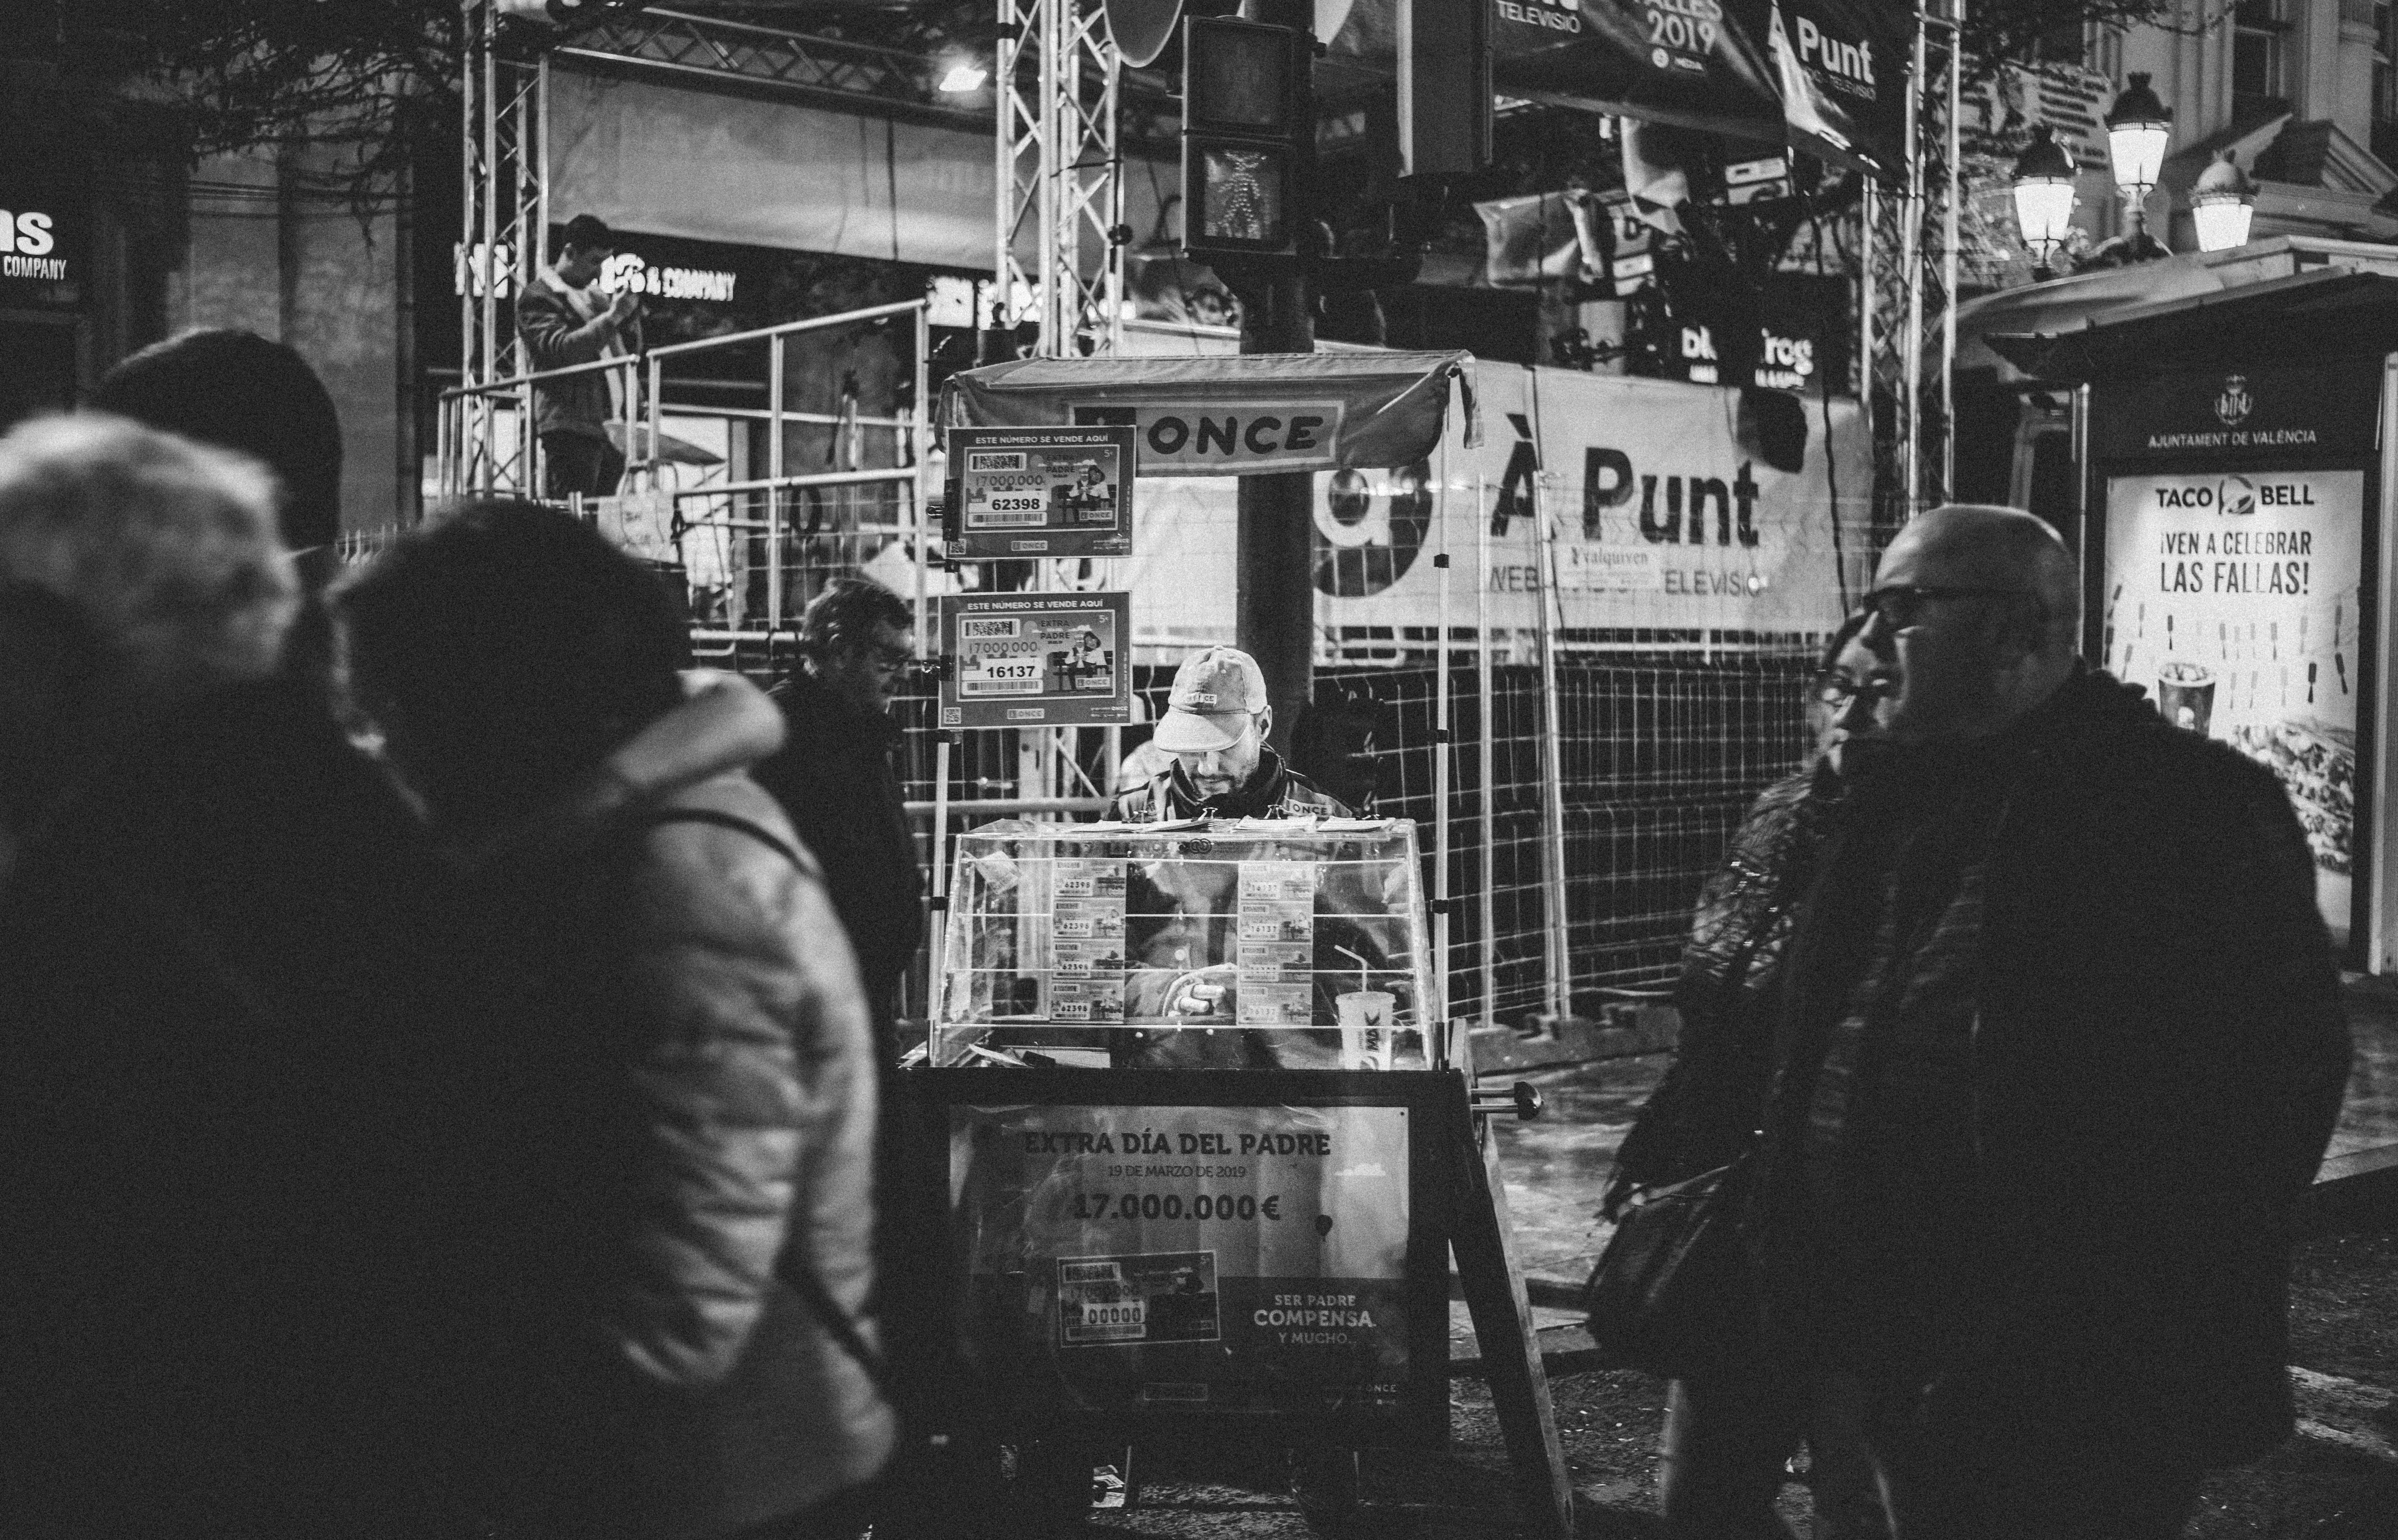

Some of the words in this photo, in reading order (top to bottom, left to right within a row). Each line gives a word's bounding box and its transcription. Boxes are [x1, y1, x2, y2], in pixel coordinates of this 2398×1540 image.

[1648, 9, 1716, 56] 2019
[1796, 16, 1875, 84] Punt
[3, 256, 66, 280] COMPANY
[1086, 434, 1108, 442] AQUÍ
[1148, 416, 1324, 456] ONCE
[2148, 433, 2227, 448] AJUNTAMENT
[2232, 432, 2248, 445] DE
[992, 499, 1040, 510] 62398
[1584, 446, 1759, 546] Punt
[2156, 487, 2213, 507] TACO
[2261, 484, 2314, 505] BELL
[2207, 532, 2216, 555] A
[2223, 531, 2312, 555] CELEBRAR
[2161, 562, 2203, 593] LAS
[2214, 561, 2309, 594] FALLAS!
[992, 601, 1031, 609] NÚMERO
[1080, 599, 1104, 607] AQUÍ
[987, 666, 1035, 678] 16137
[1293, 804, 1327, 816] ONCE
[1024, 1132, 1115, 1154] EXTRA
[1121, 1128, 1172, 1154] DÍA
[1179, 1133, 1232, 1155] DEL
[1240, 1134, 1331, 1156] PADRE
[1108, 1166, 1123, 1177] 19
[1126, 1166, 1144, 1177] DE
[1145, 1166, 1193, 1177] MARZO
[1196, 1166, 1214, 1177] DE
[1216, 1166, 1245, 1177] 2019
[1074, 1194, 1280, 1221] 17.000.000€
[1275, 1294, 1302, 1306] SER
[1307, 1295, 1356, 1306] PADRE
[1089, 1308, 1141, 1324] 00000
[1278, 1332, 1287, 1344] Y
